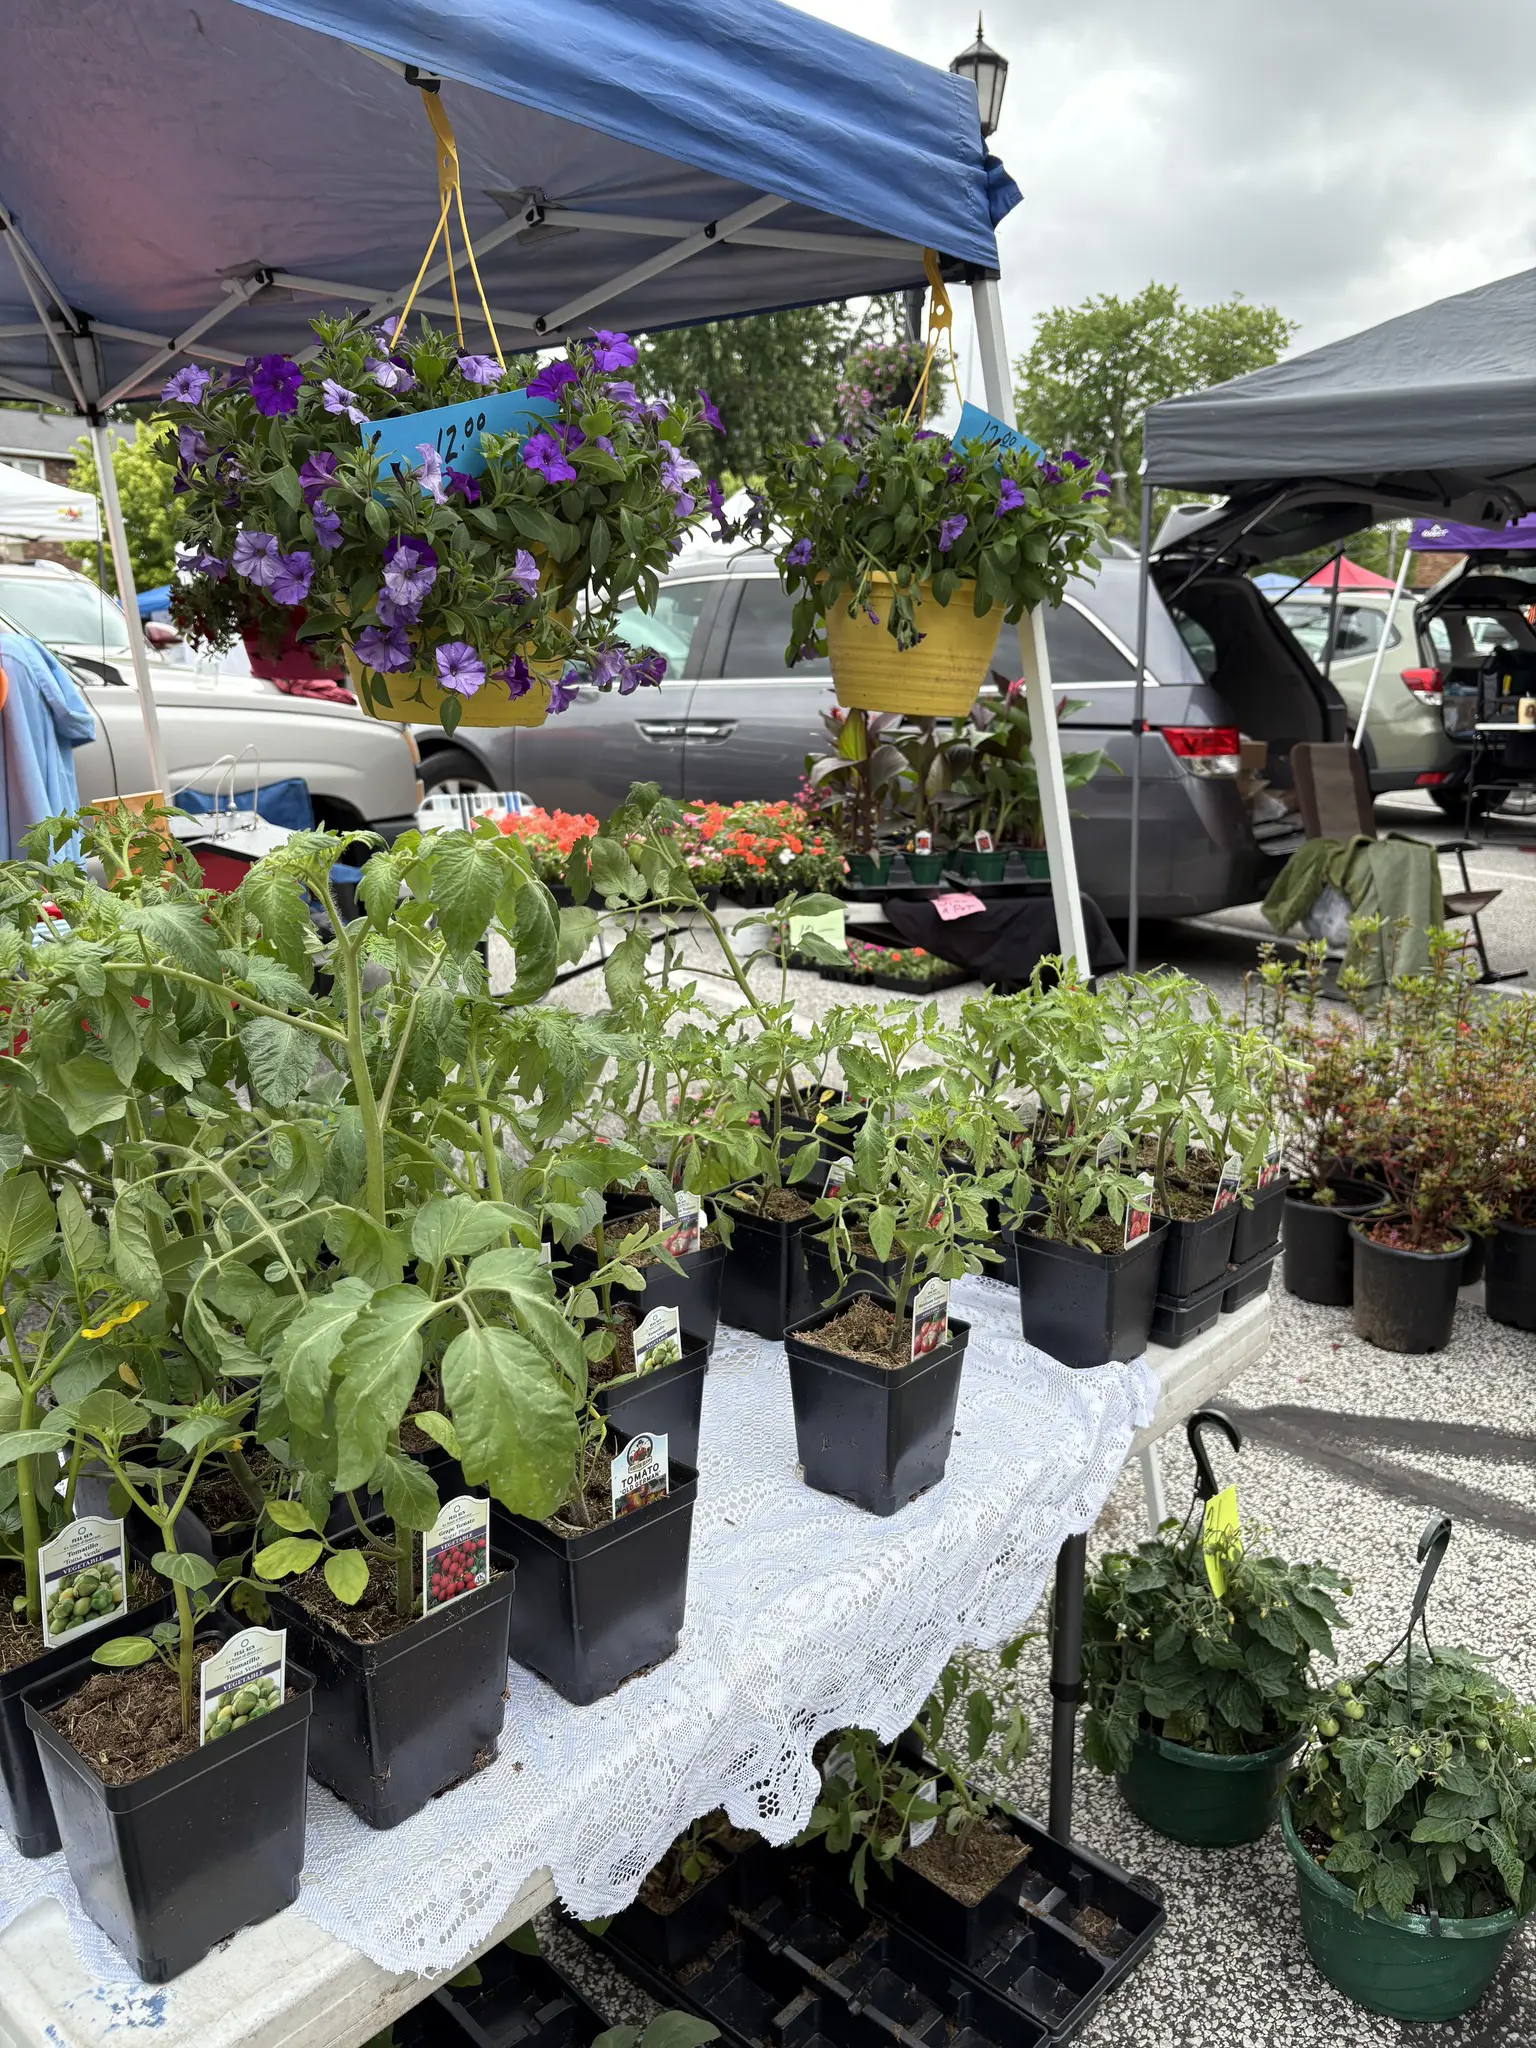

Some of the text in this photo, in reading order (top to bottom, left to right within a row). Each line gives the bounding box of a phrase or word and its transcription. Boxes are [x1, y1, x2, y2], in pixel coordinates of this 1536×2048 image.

[437, 413, 486, 464] 12.00
[621, 1463, 659, 1488] TOMATO
[67, 1543, 99, 1557] Tomatillo
[440, 1533, 473, 1550] VEGETABLE
[62, 1555, 104, 1575] VEGETABLE
[228, 1656, 260, 1672] Tomatillo
[223, 1669, 265, 1691] VEGETABLE
